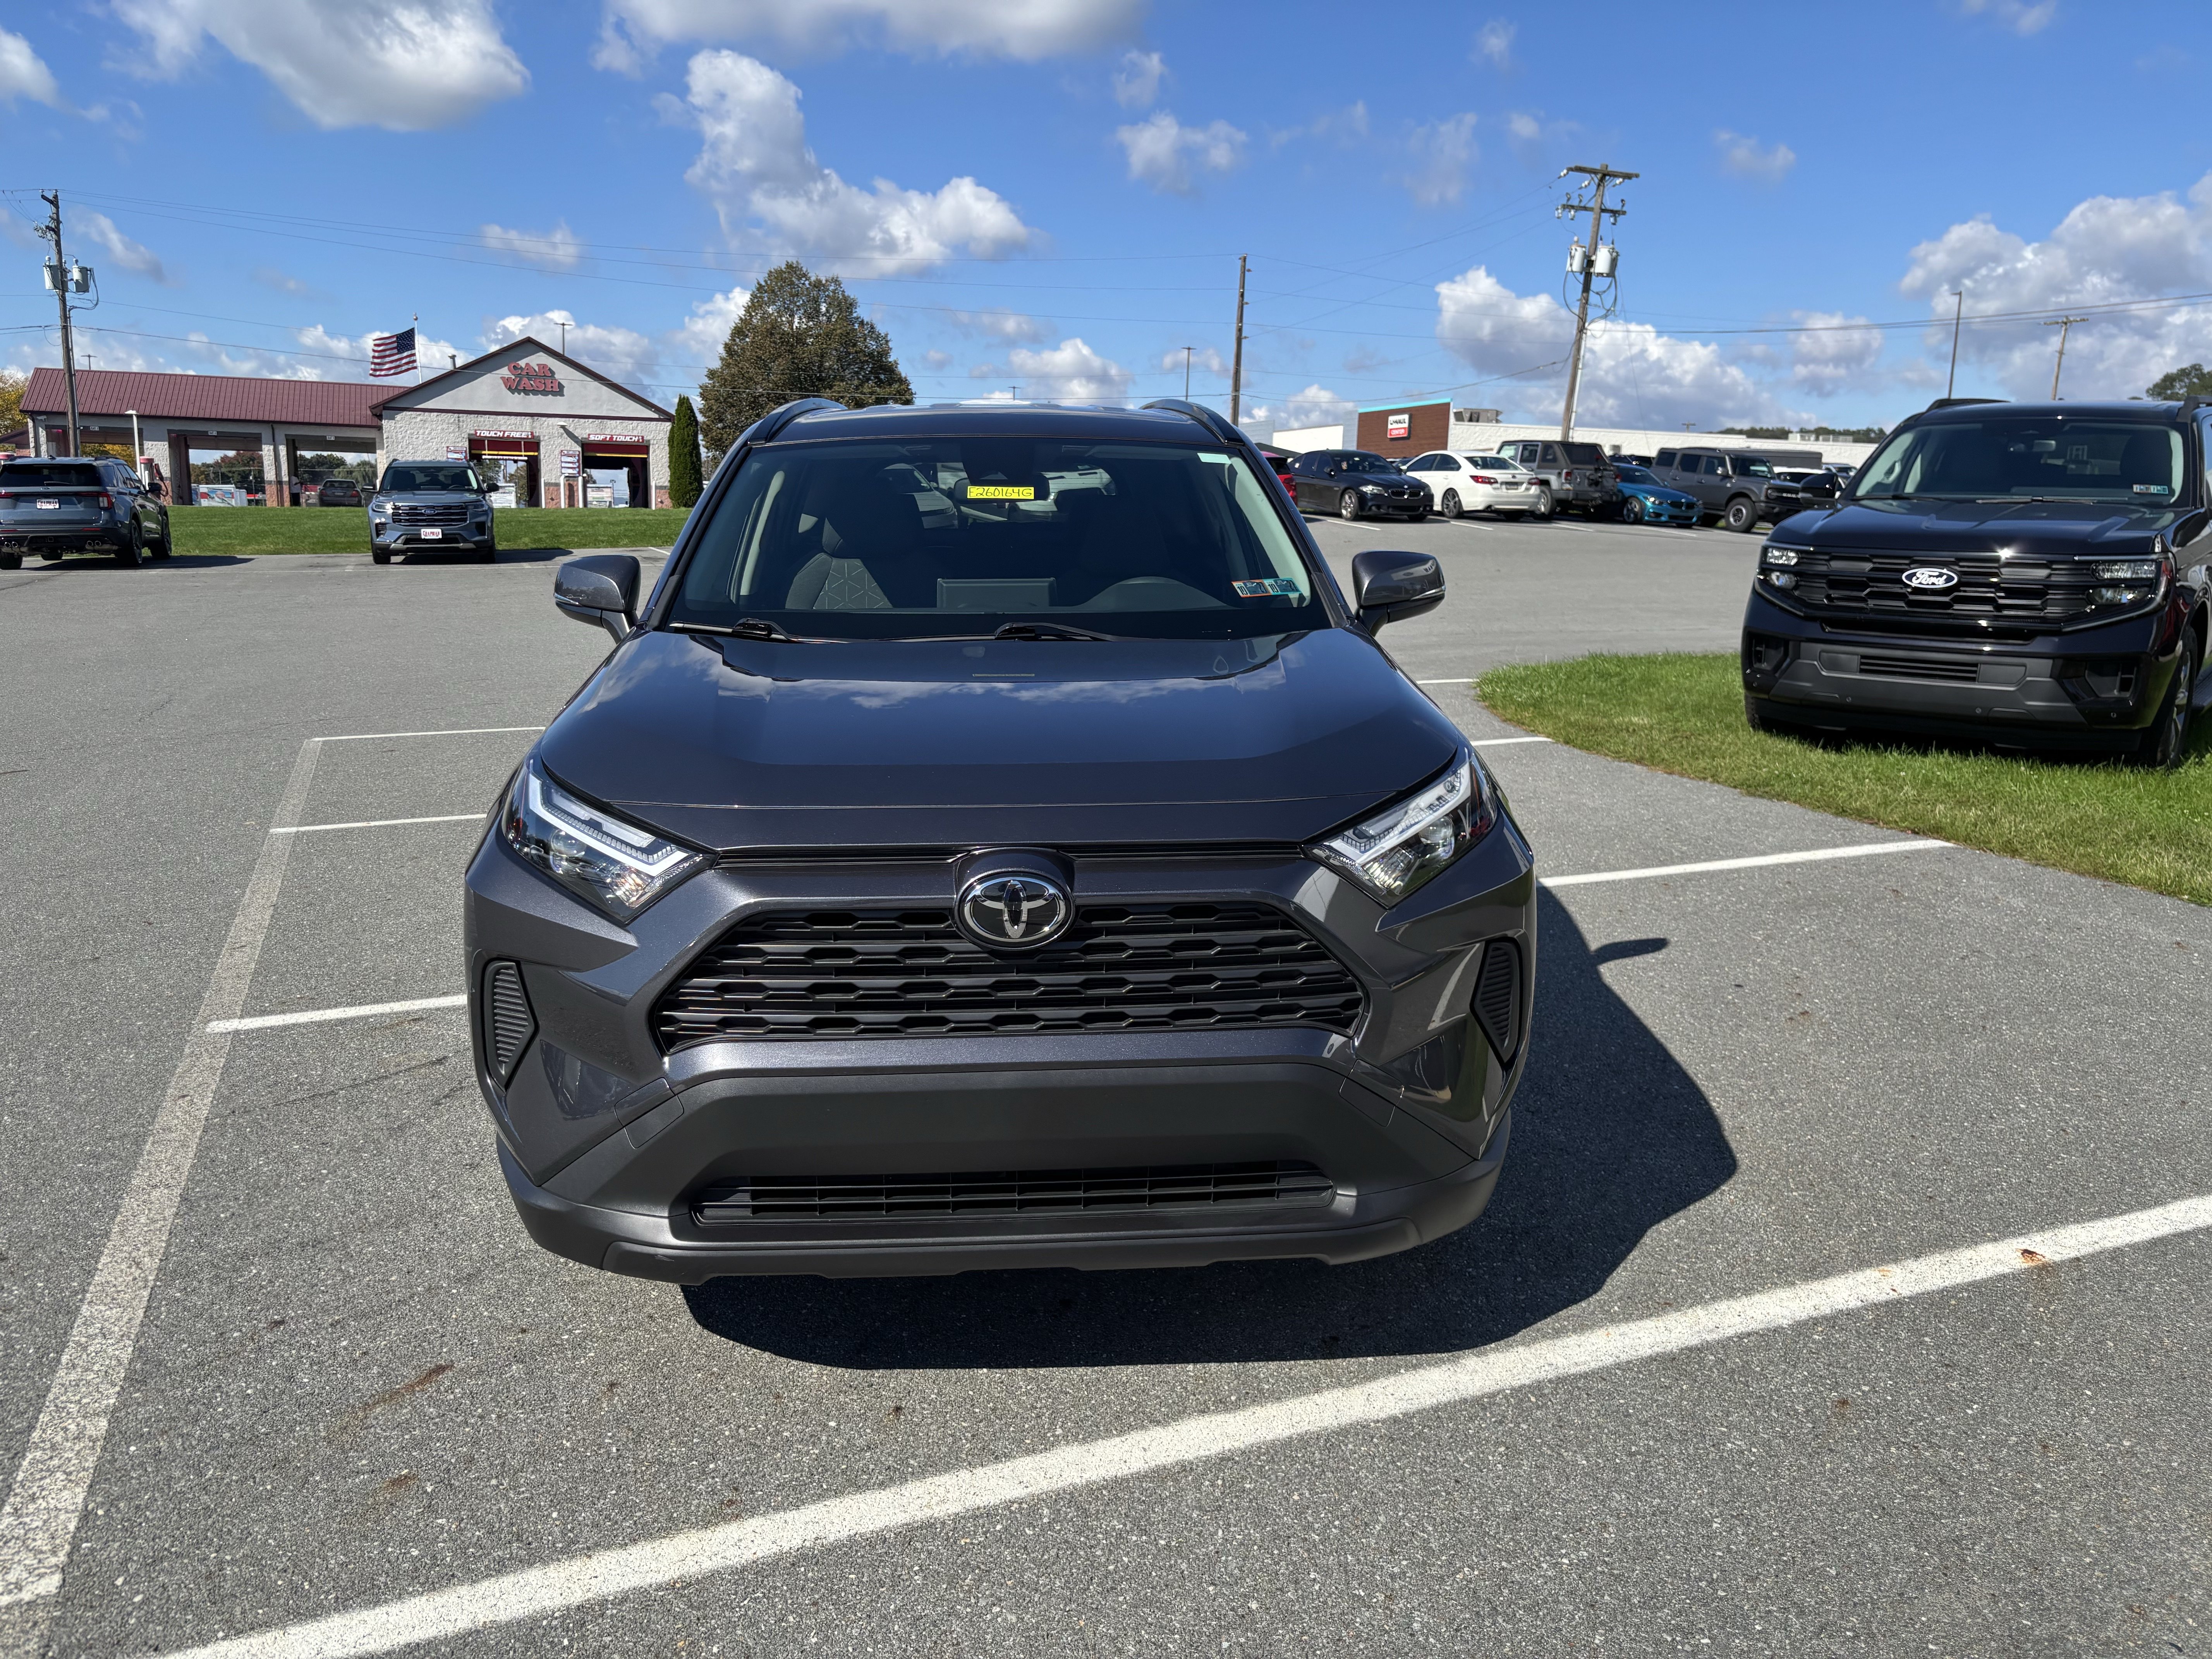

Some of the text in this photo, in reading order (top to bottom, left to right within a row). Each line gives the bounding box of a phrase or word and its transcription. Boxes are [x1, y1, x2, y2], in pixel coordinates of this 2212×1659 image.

[508, 361, 551, 376] CAR
[500, 376, 559, 391] WASH
[969, 487, 1032, 497] E260164G
[1912, 570, 1948, 585] Ford
[1237, 586, 1248, 595] 10
[1268, 584, 1279, 592] 10
